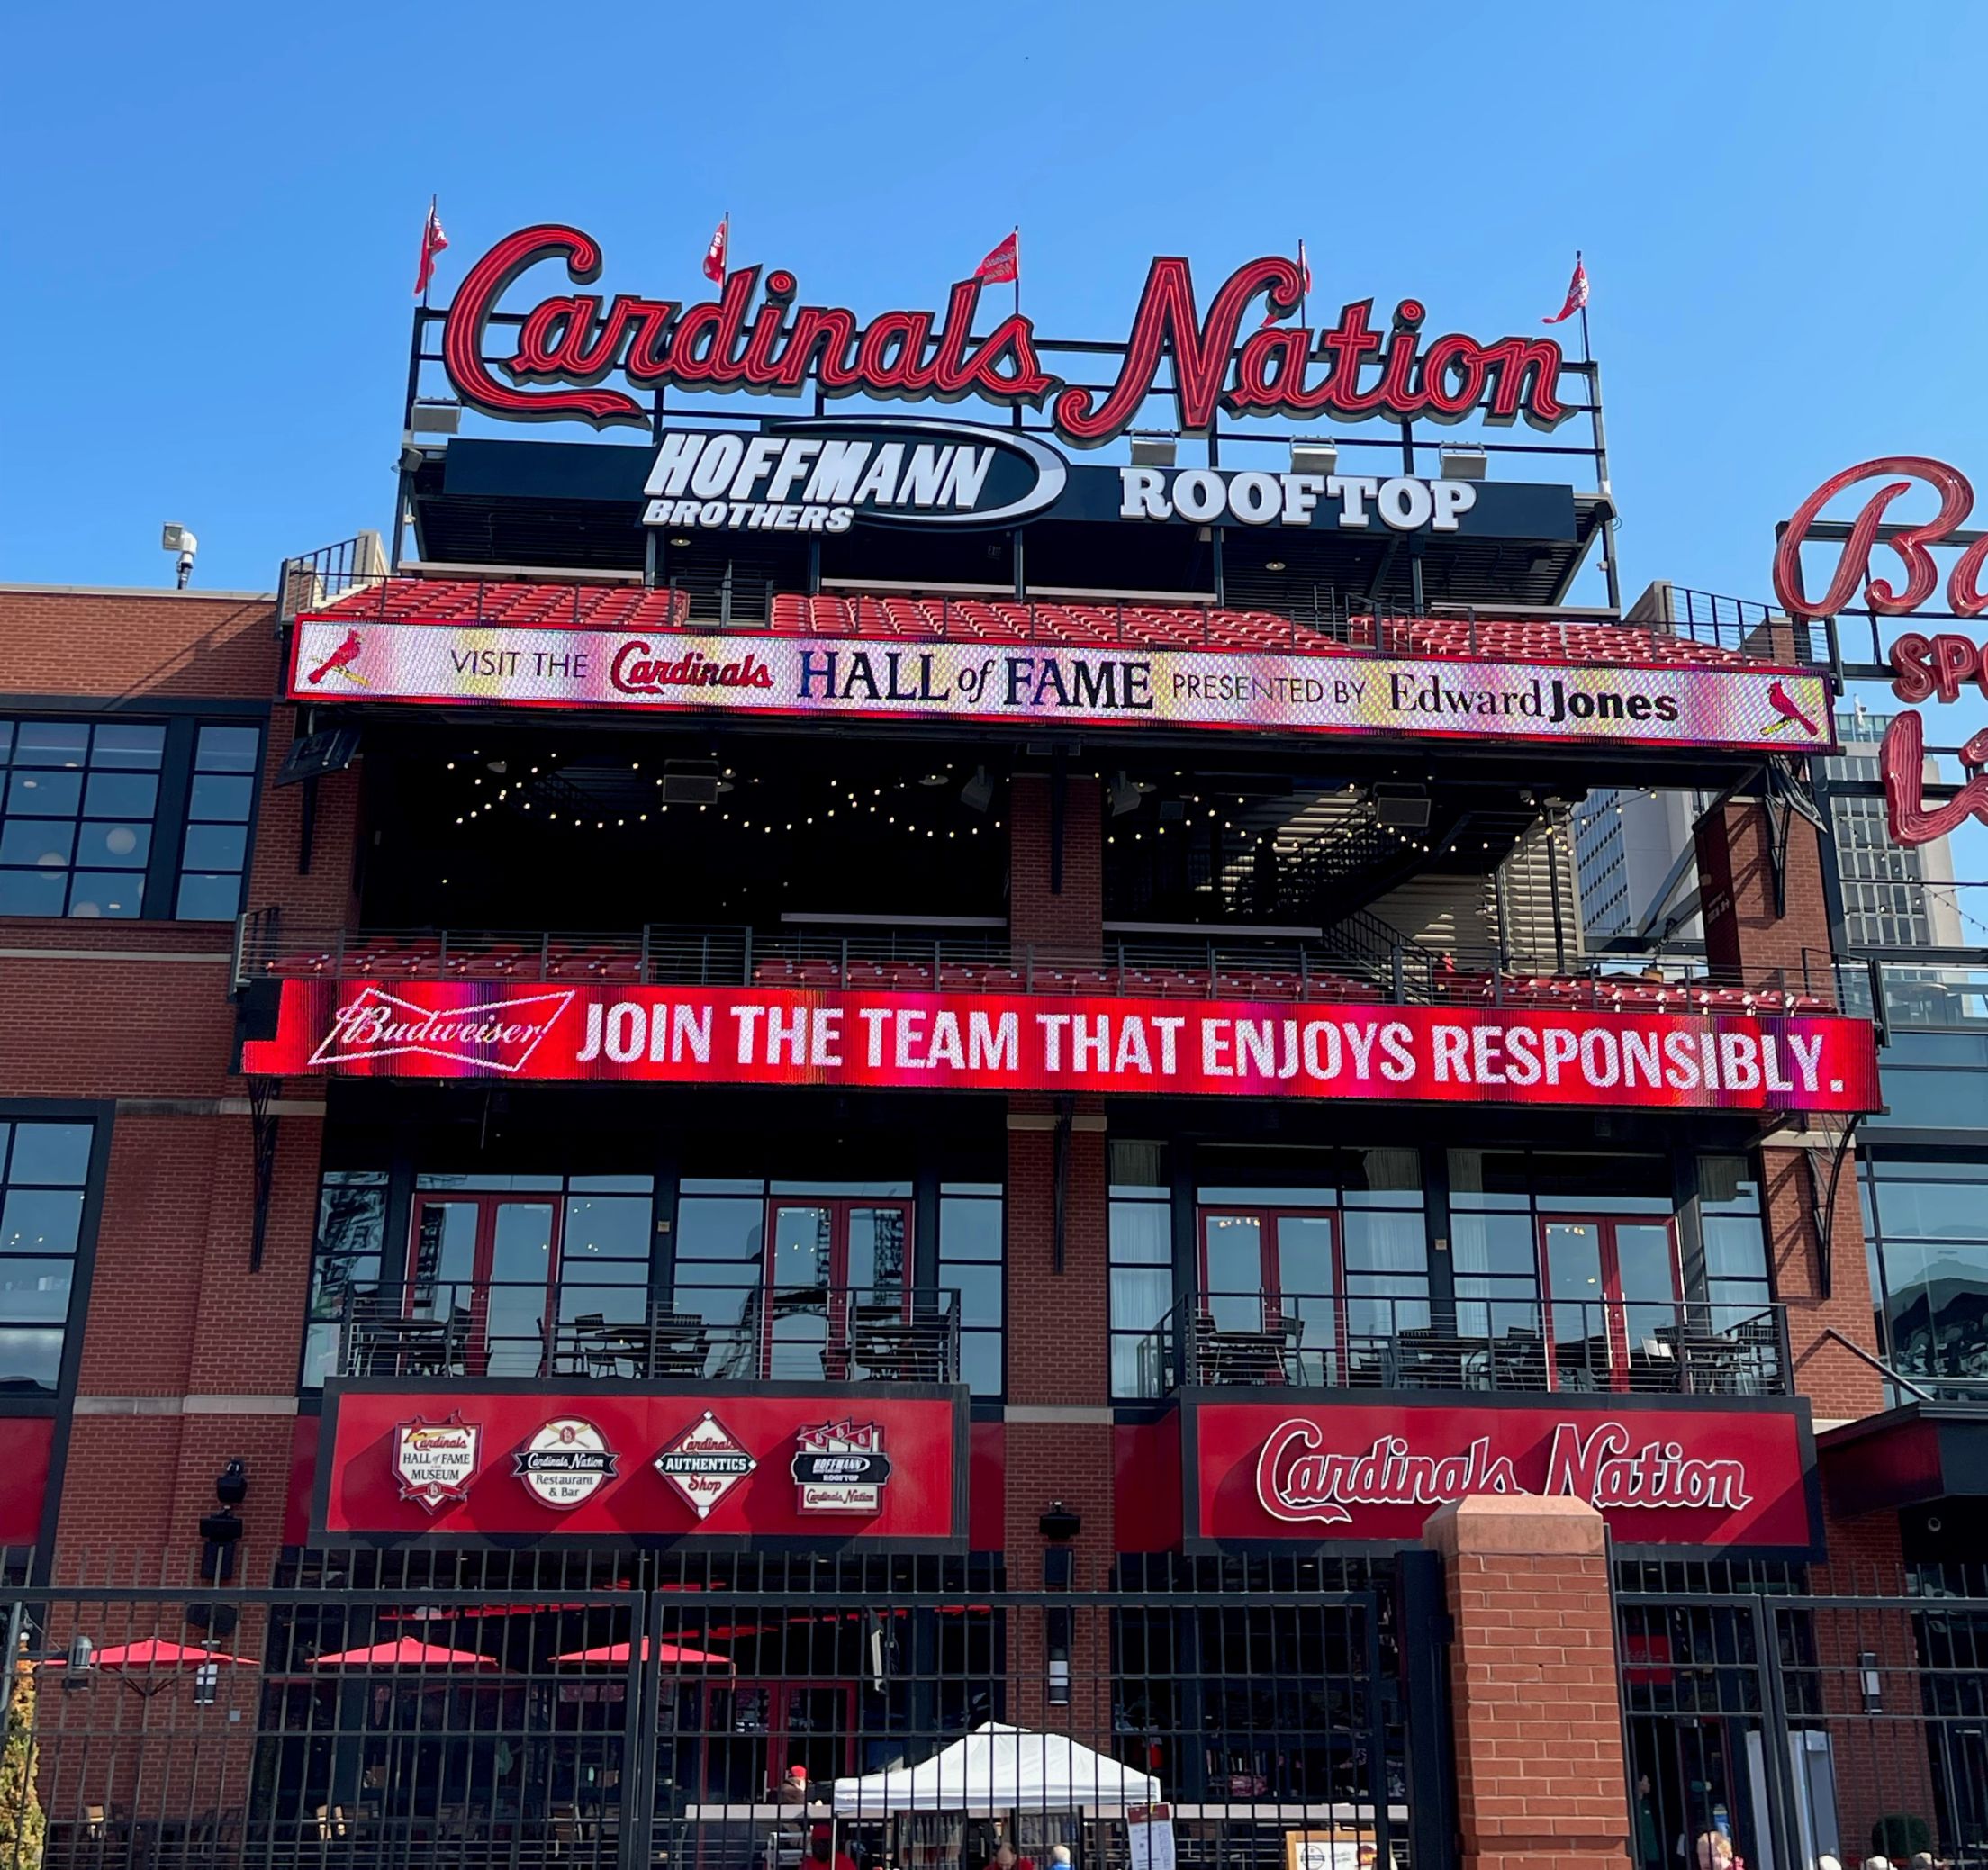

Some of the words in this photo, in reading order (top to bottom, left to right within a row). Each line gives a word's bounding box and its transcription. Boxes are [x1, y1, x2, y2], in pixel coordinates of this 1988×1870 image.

[444, 224, 1064, 430] Cardinals
[1051, 255, 1579, 449] Nation
[642, 432, 996, 511] HOFFMANN
[1119, 466, 1477, 531] ROOFTOP
[641, 499, 855, 533] BROTHERS
[450, 649, 520, 676] VISIT
[534, 651, 588, 679] THE
[610, 640, 773, 695] Cardinals
[797, 650, 950, 701] HALL
[957, 659, 996, 703] of
[1002, 656, 1153, 709] FAME
[1172, 674, 1324, 704] PRESENTED
[1334, 678, 1367, 705] BY
[1889, 633, 1988, 704] SP
[336, 1002, 545, 1045] Budweiser
[576, 1002, 714, 1063] JOIN
[730, 1005, 843, 1066] THE
[859, 1008, 1019, 1071] TEAM
[1035, 1013, 1185, 1075] THAT
[1201, 1017, 1417, 1083] ENJOYS
[1431, 1023, 1844, 1093] RESPONSIBLY.
[402, 1452, 432, 1464] HALL
[441, 1453, 470, 1465] FAME
[414, 1432, 467, 1451] Cardinals
[411, 1468, 460, 1481] MUSEUM
[528, 1452, 569, 1469] Cardinals
[568, 1453, 604, 1469] Nation
[665, 1458, 746, 1471] AUTHENTICS
[1256, 1418, 1530, 1524] Cardinals
[1543, 1422, 1753, 1510] Nation
[536, 1474, 594, 1486] Restaurant
[548, 1487, 557, 1497] &
[561, 1487, 580, 1497] Bar
[688, 1473, 722, 1495] Shop
